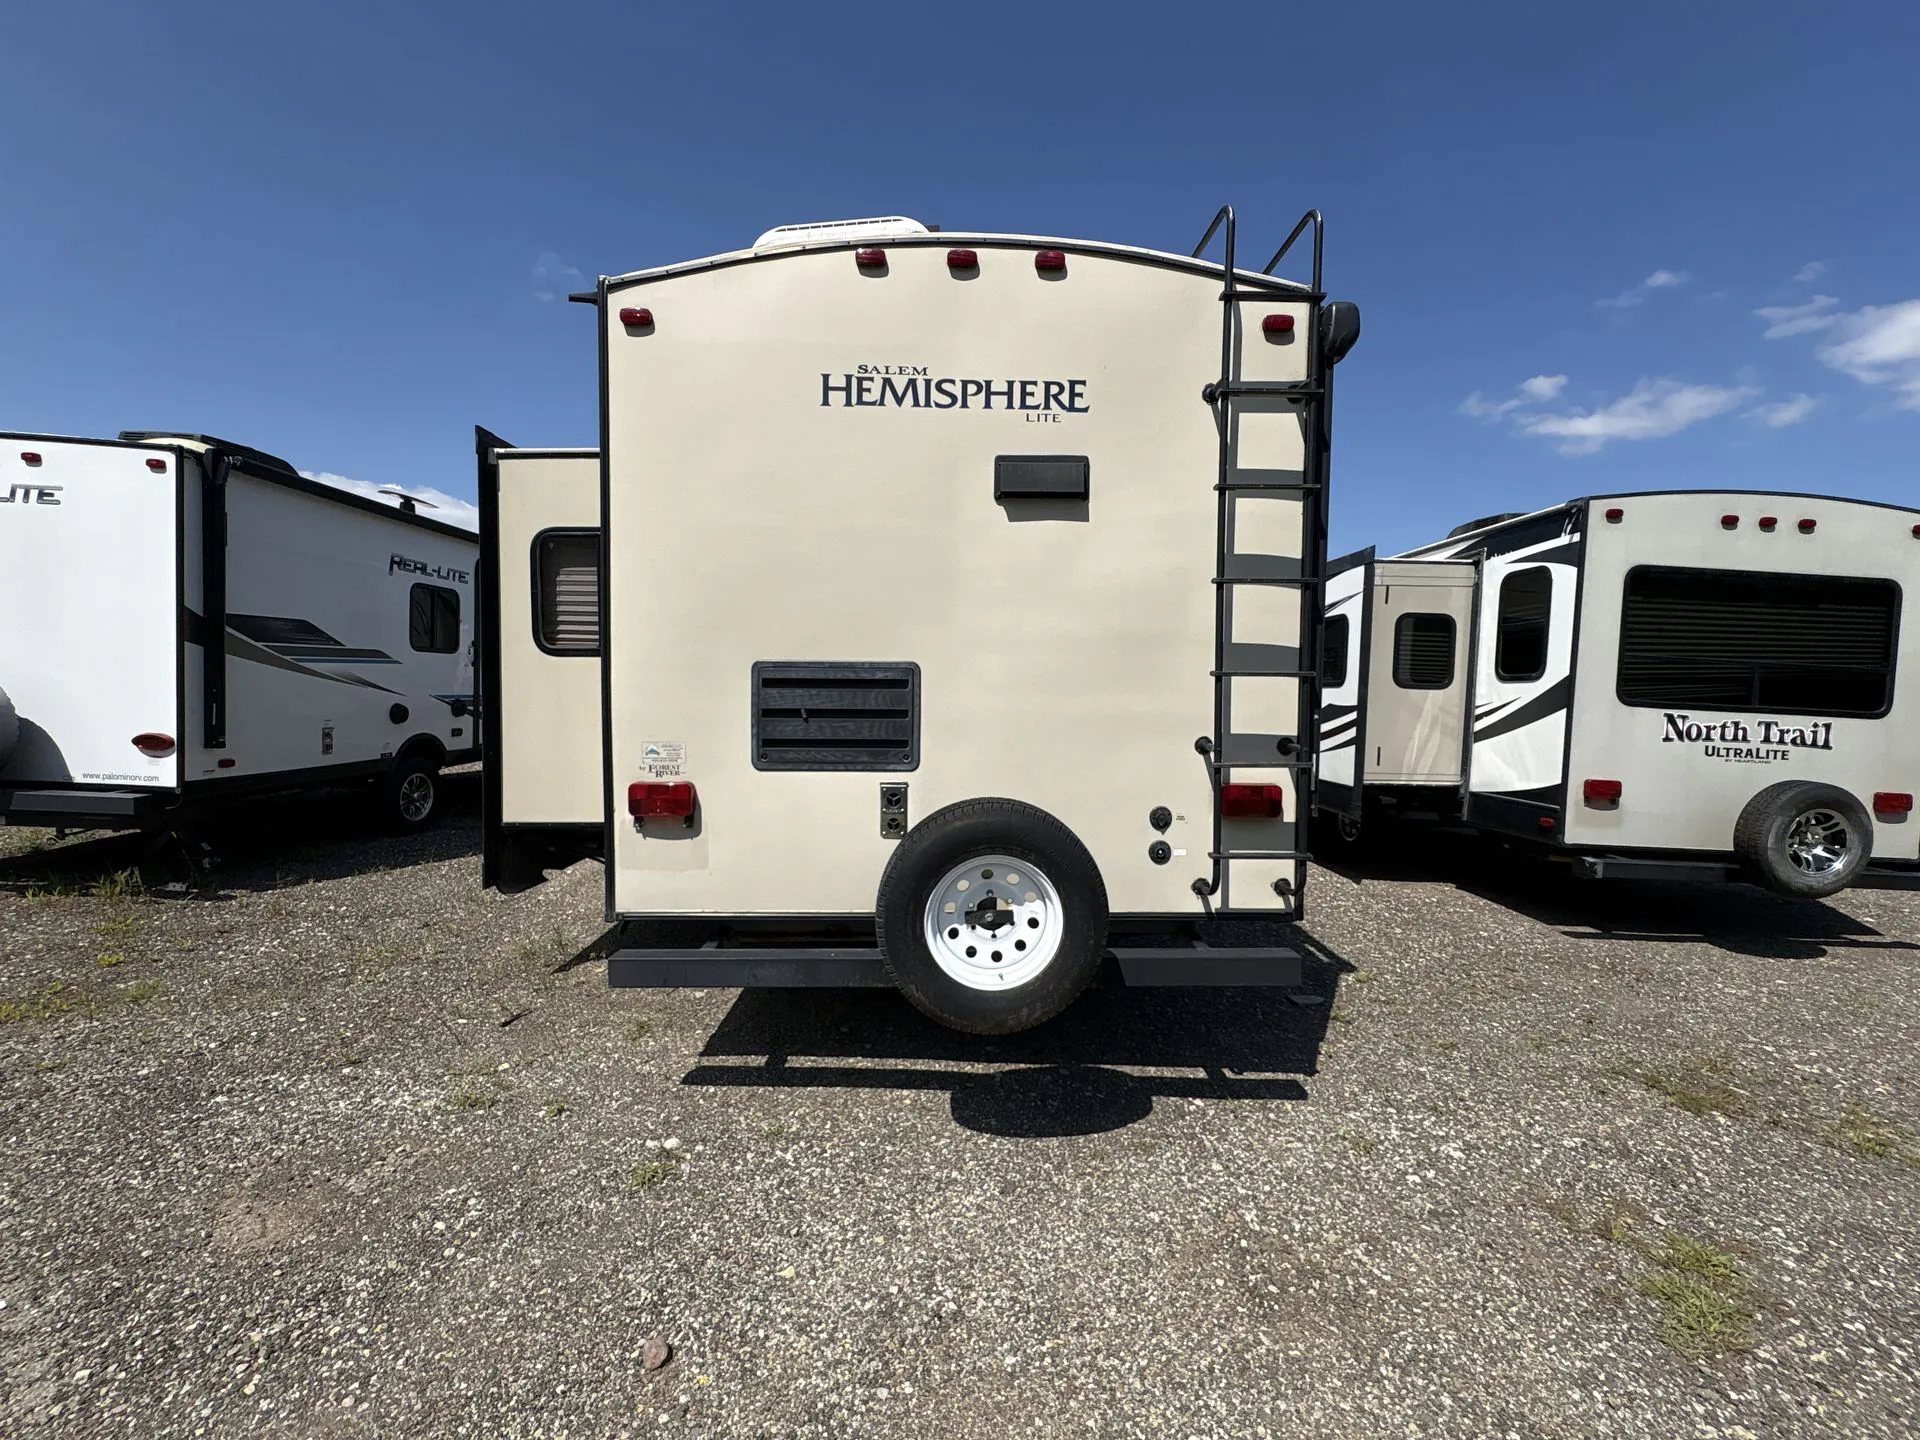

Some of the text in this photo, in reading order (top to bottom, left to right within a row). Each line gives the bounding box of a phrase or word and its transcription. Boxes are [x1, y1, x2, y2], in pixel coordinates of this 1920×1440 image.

[857, 364, 929, 376] SALEM
[820, 373, 1090, 413] HEMISPHERE
[1026, 412, 1062, 423] LITE
[1662, 712, 1833, 750] North Trail
[82, 772, 159, 782] www.palominorv.com
